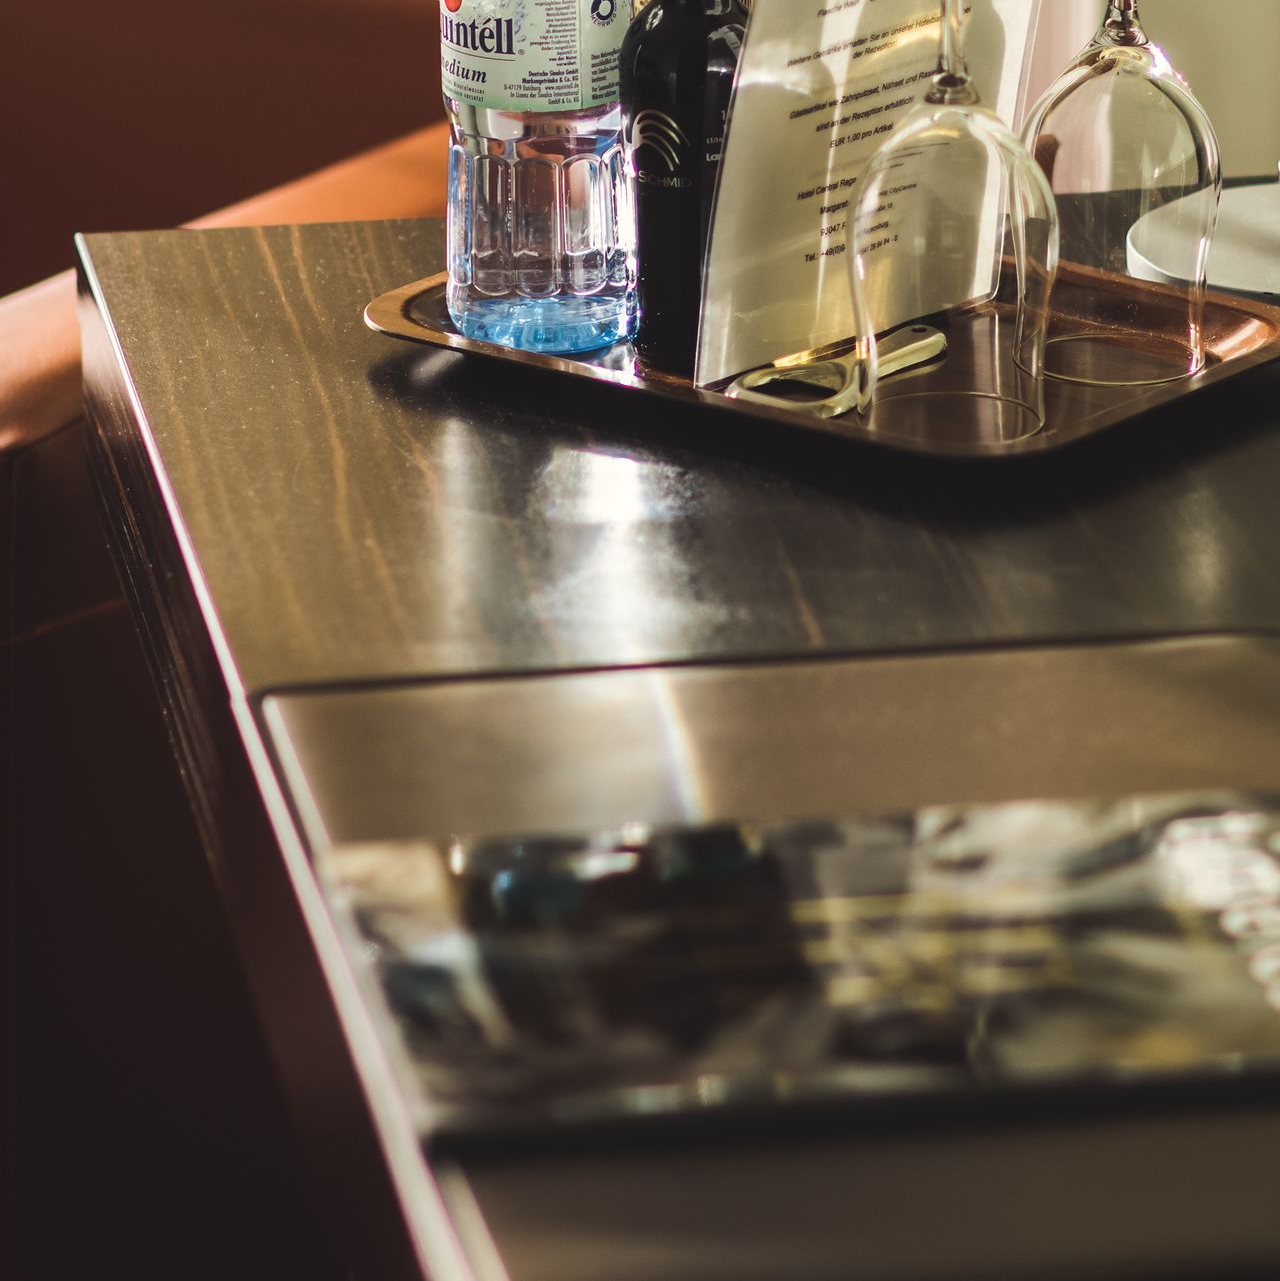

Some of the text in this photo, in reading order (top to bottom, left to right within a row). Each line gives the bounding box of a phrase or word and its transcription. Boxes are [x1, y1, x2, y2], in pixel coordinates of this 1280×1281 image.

[441, 57, 487, 84] edium
[905, 76, 918, 85] und
[839, 115, 852, 126] der
[851, 106, 884, 121] Rezeption
[861, 129, 873, 141] pro
[796, 188, 815, 200] Hotel
